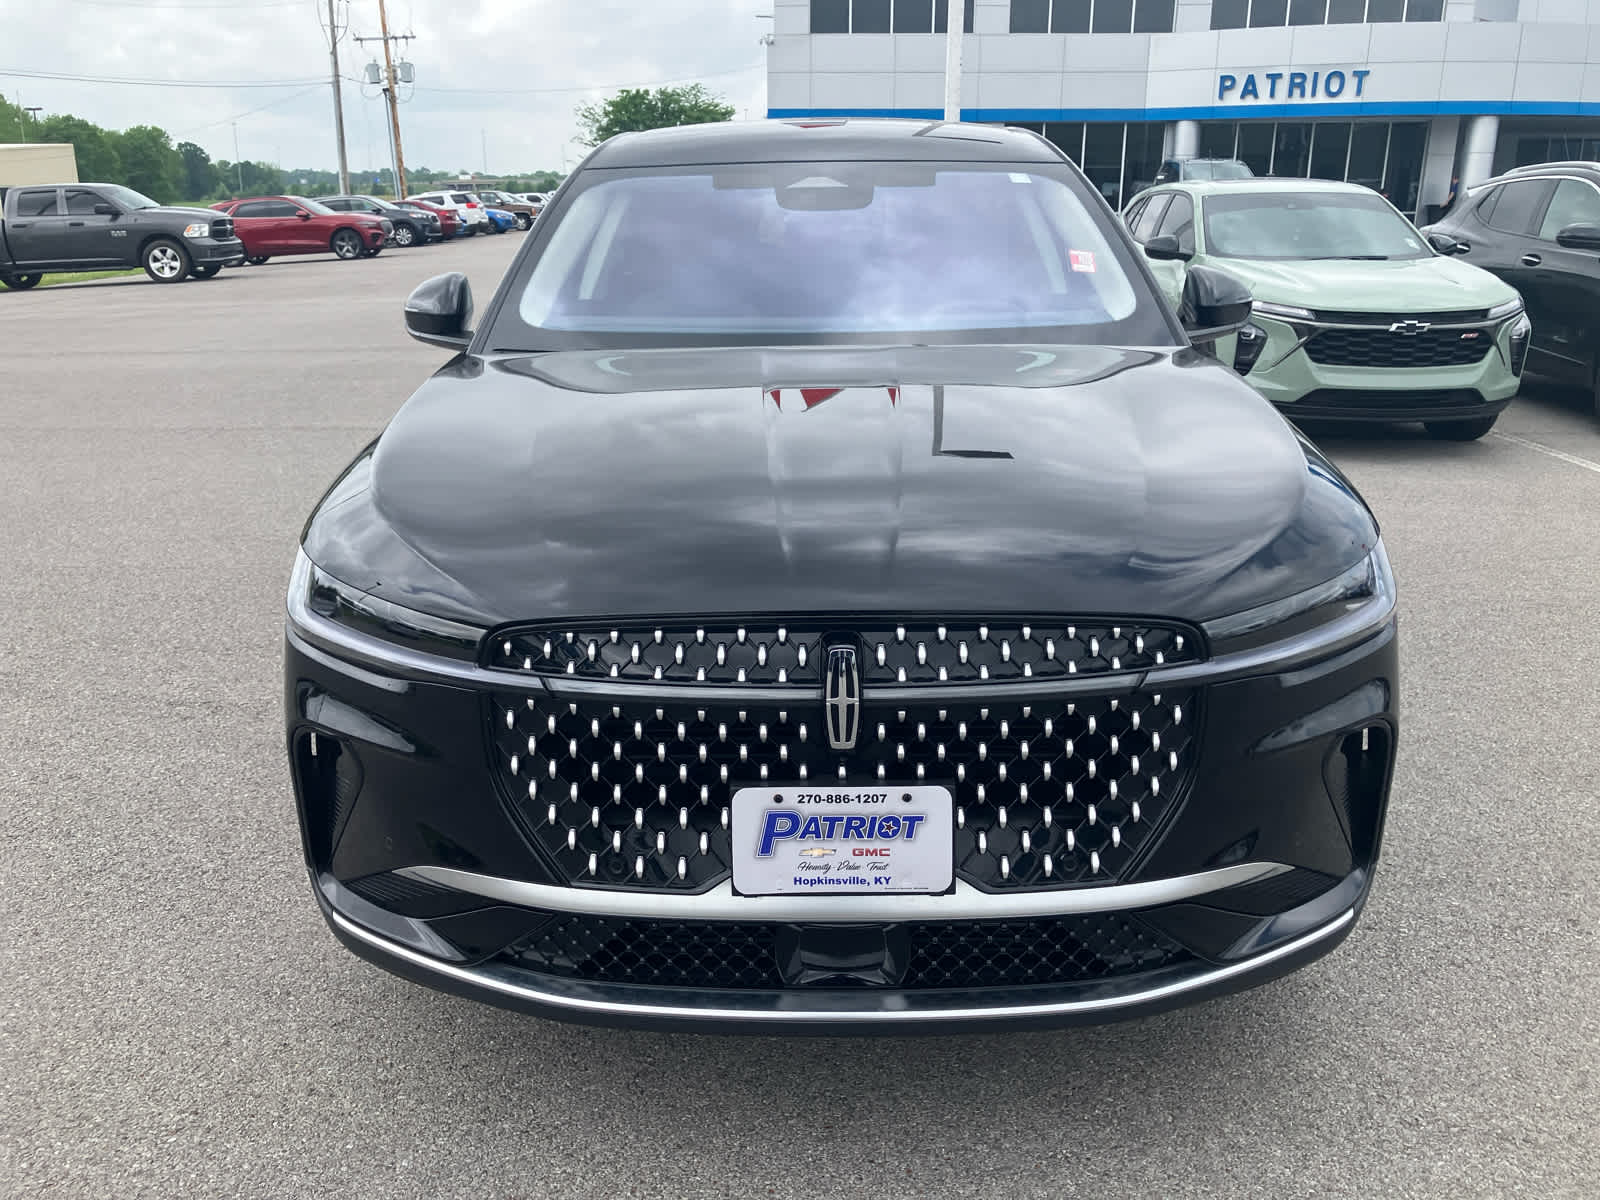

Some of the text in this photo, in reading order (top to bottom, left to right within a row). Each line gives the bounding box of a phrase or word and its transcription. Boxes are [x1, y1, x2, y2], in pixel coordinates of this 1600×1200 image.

[1218, 70, 1370, 101] PATRIOT
[797, 794, 888, 804] 270-886-1207
[755, 809, 926, 858] PATRIOT
[852, 848, 891, 857] GMC
[866, 861, 889, 872] Trust
[793, 876, 892, 887] Hopkinsville, KY
